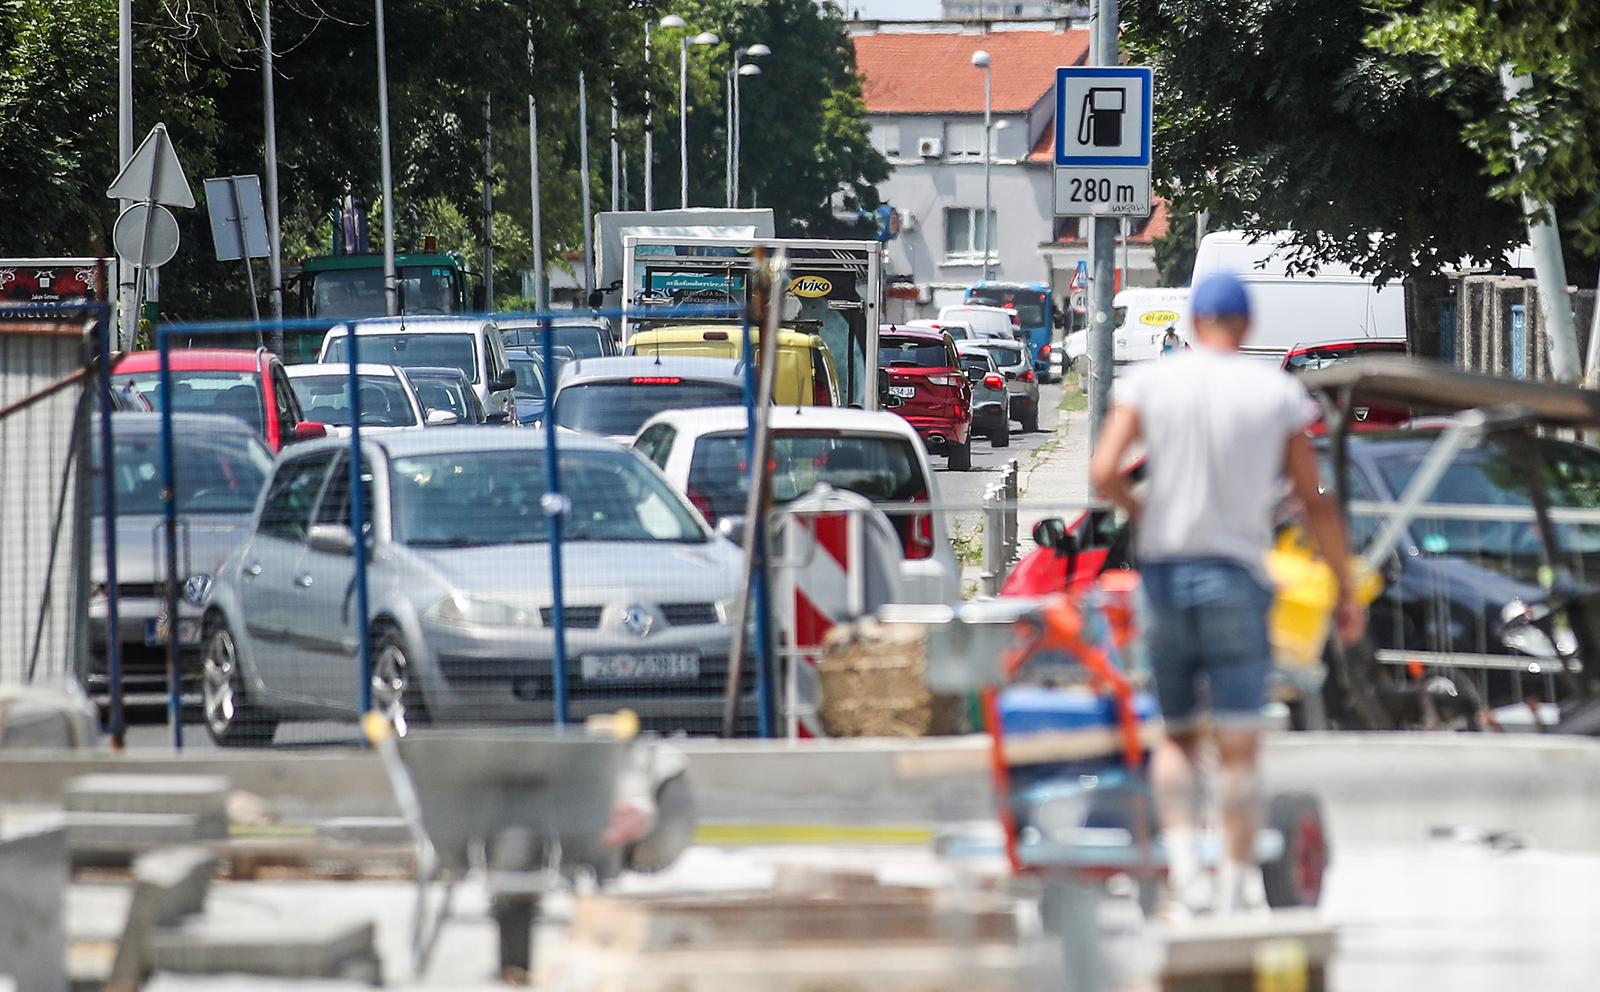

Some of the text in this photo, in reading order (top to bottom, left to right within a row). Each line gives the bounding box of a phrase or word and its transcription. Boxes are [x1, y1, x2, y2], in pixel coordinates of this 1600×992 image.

[1070, 178, 1134, 203] 280 m
[792, 279, 830, 292] Aviko
